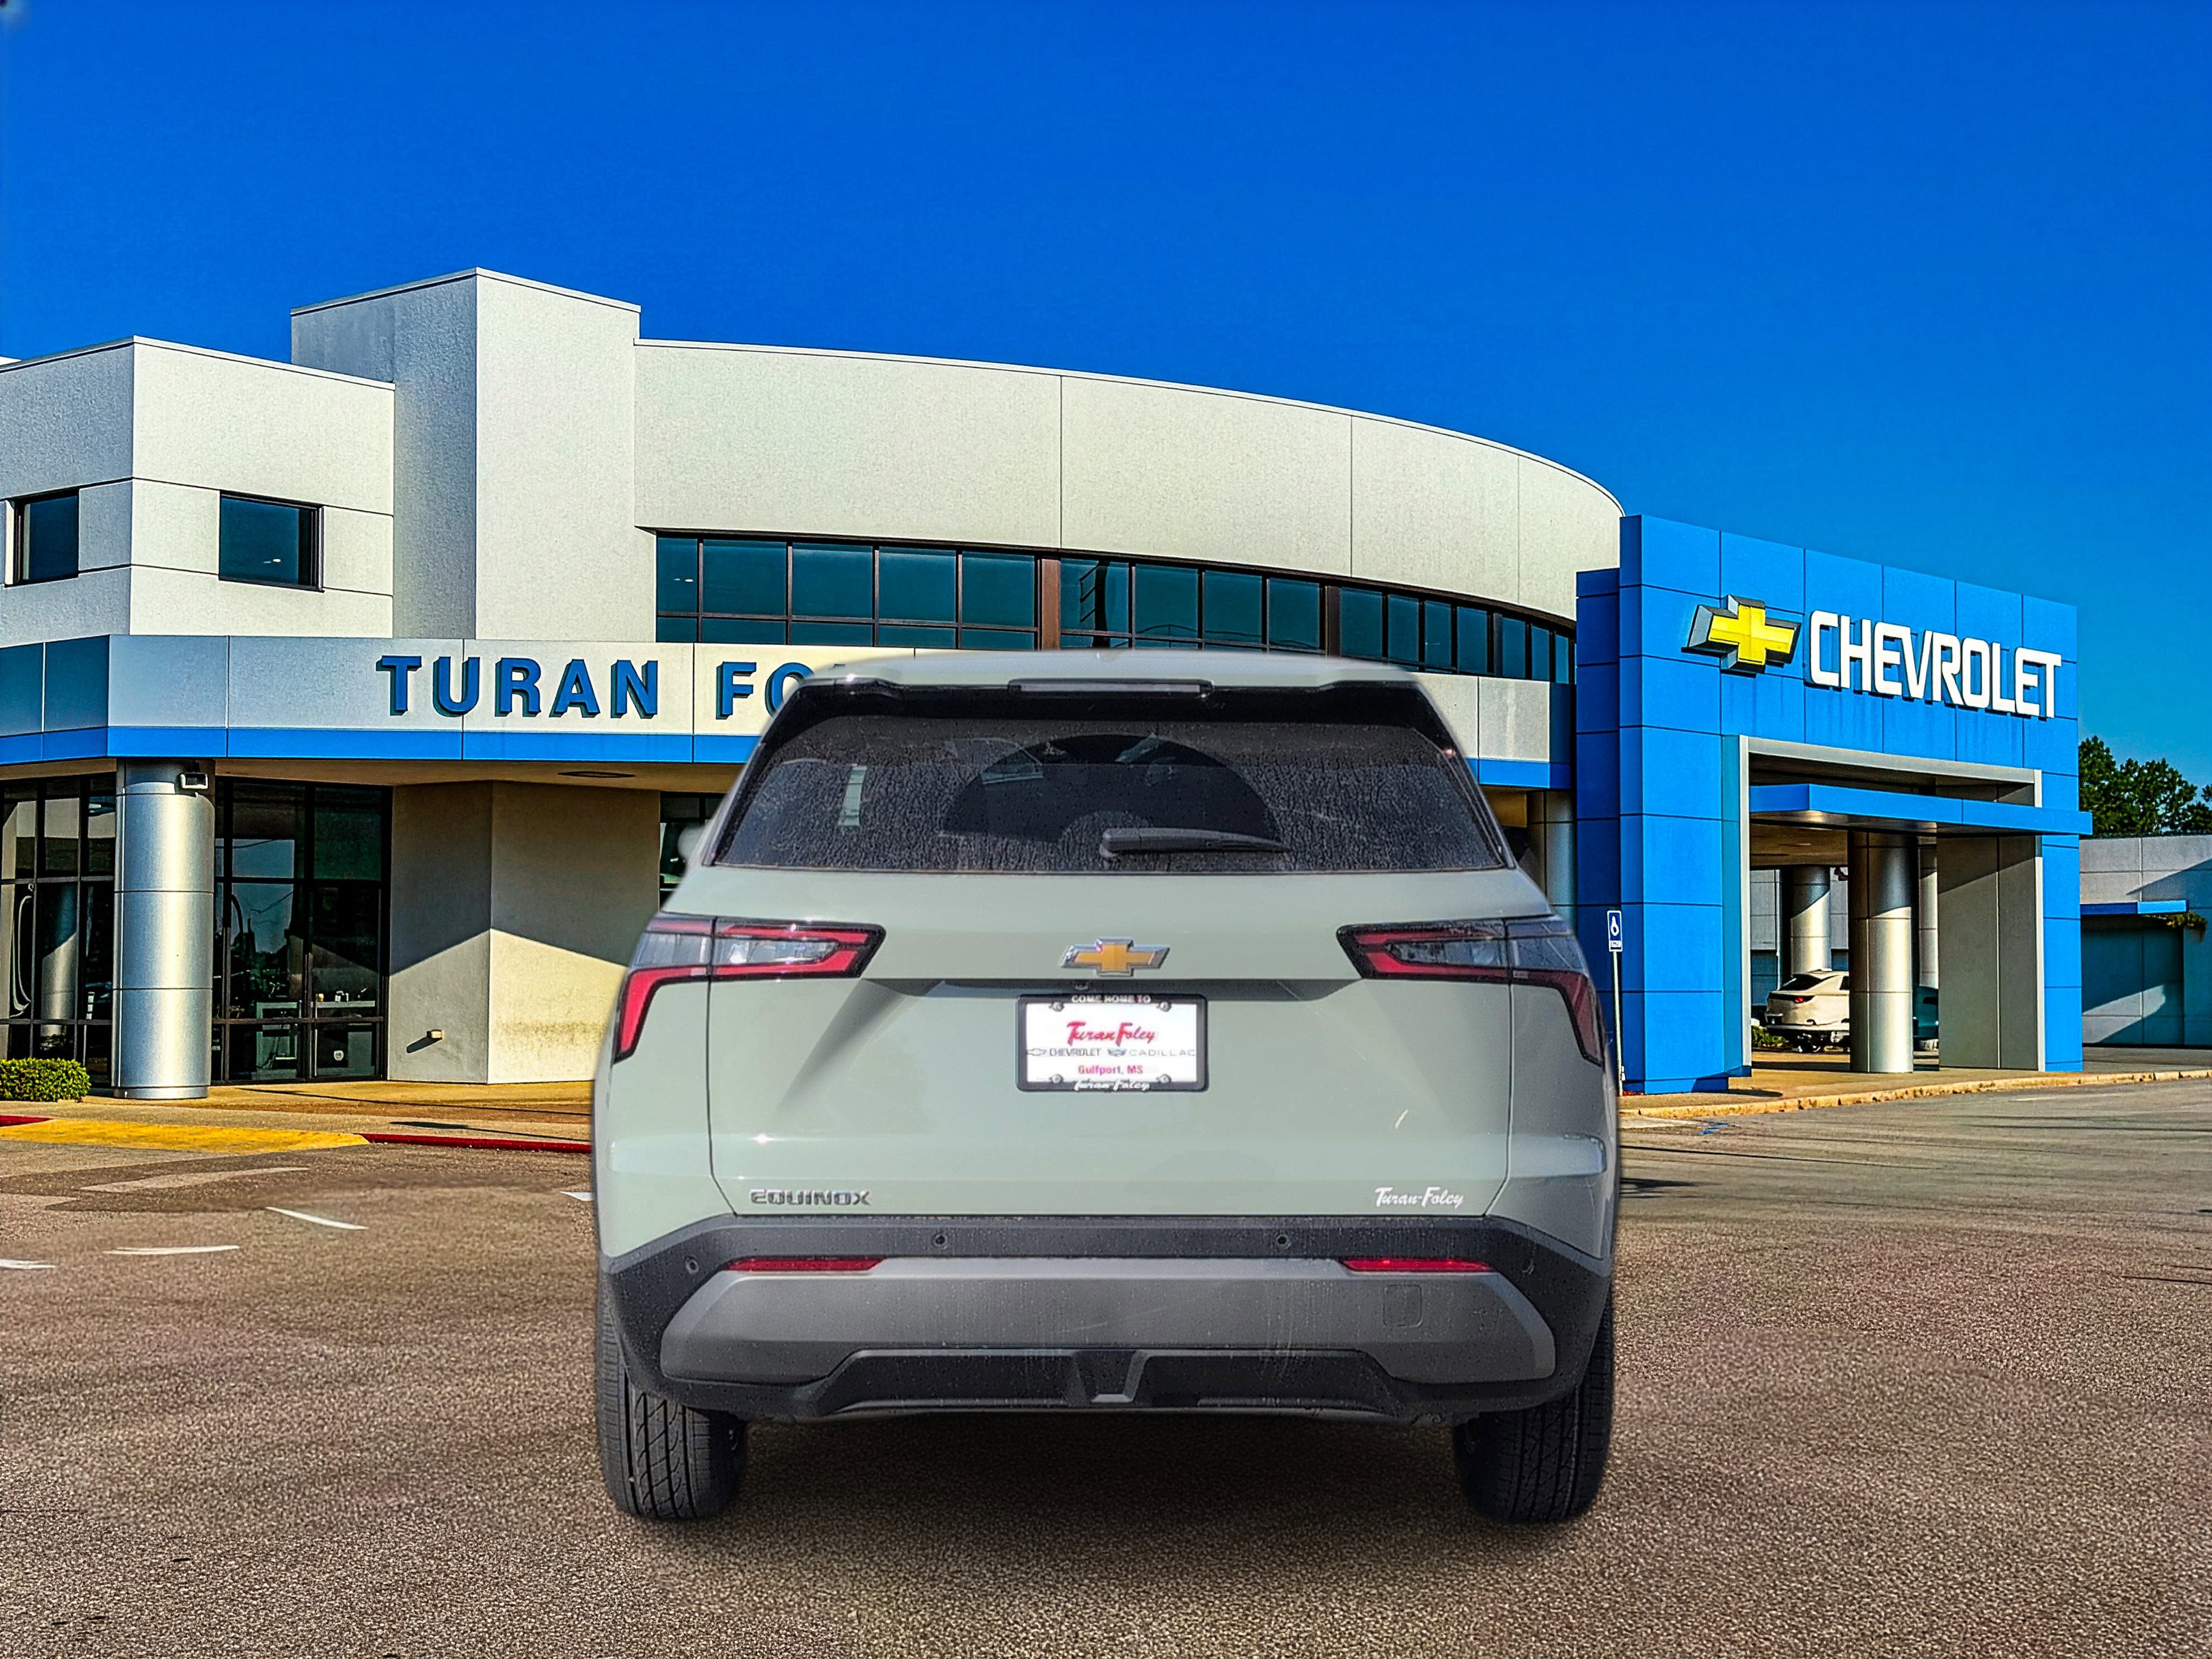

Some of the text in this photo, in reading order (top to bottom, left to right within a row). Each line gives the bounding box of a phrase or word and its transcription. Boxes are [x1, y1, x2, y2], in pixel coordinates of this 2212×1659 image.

[1809, 609, 2062, 719] CHEVROLET
[376, 655, 814, 720] TURAN FO
[1066, 1021, 1155, 1047] Turan Foley
[1049, 1047, 1102, 1057] CHEVROLET
[1129, 1049, 1196, 1057] CADILLAC
[1078, 1065, 1143, 1076] Gulfport, MS
[750, 1189, 870, 1205] EQUINOX
